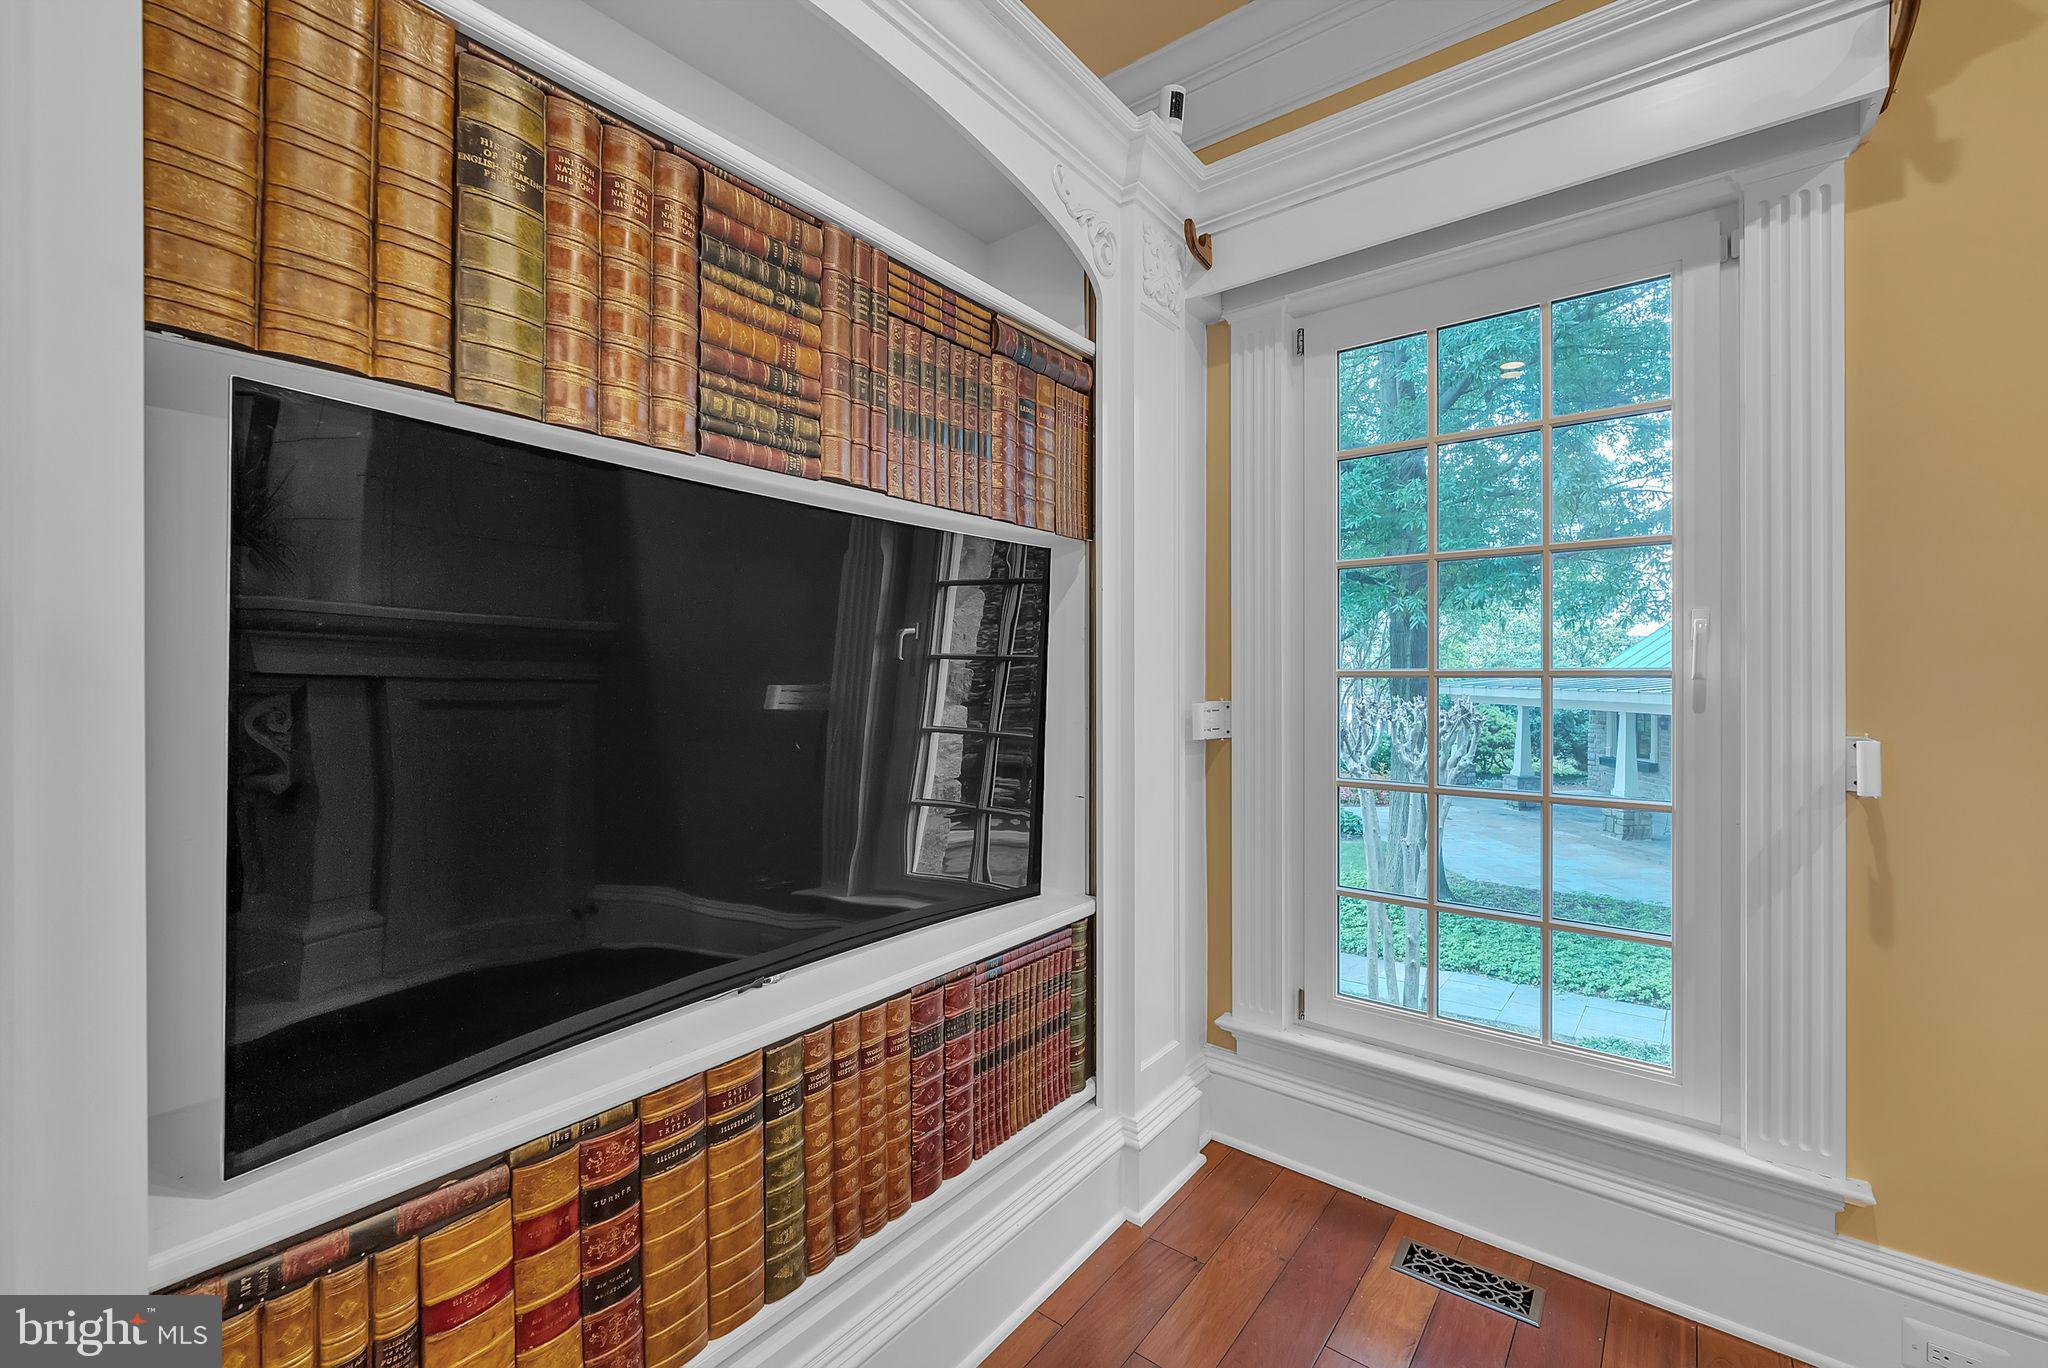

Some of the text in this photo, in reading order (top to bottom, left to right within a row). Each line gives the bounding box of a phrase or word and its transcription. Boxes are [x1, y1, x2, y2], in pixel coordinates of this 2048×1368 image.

[480, 137, 528, 163] HISTORY
[483, 148, 498, 160] OF
[457, 151, 544, 193] ENGLISH-SPEAKING
[554, 164, 597, 187] NATURAL
[558, 155, 595, 178] BRITISH
[484, 168, 526, 193] PEOPLES
[556, 174, 595, 196] HISTORY
[614, 180, 648, 202] BRITISH
[611, 189, 649, 211] NATURAL
[613, 199, 648, 219] HISTORY
[722, 1090, 752, 1108] TRIVIA
[728, 1084, 749, 1098] GAY'S
[782, 1097, 792, 1106] OF
[664, 1111, 688, 1126] GAY'S
[778, 1102, 796, 1116] ROME
[658, 1118, 692, 1137] TRIVIA
[656, 1140, 697, 1164] ILLUSTRATED
[593, 1186, 632, 1208] TURNER
